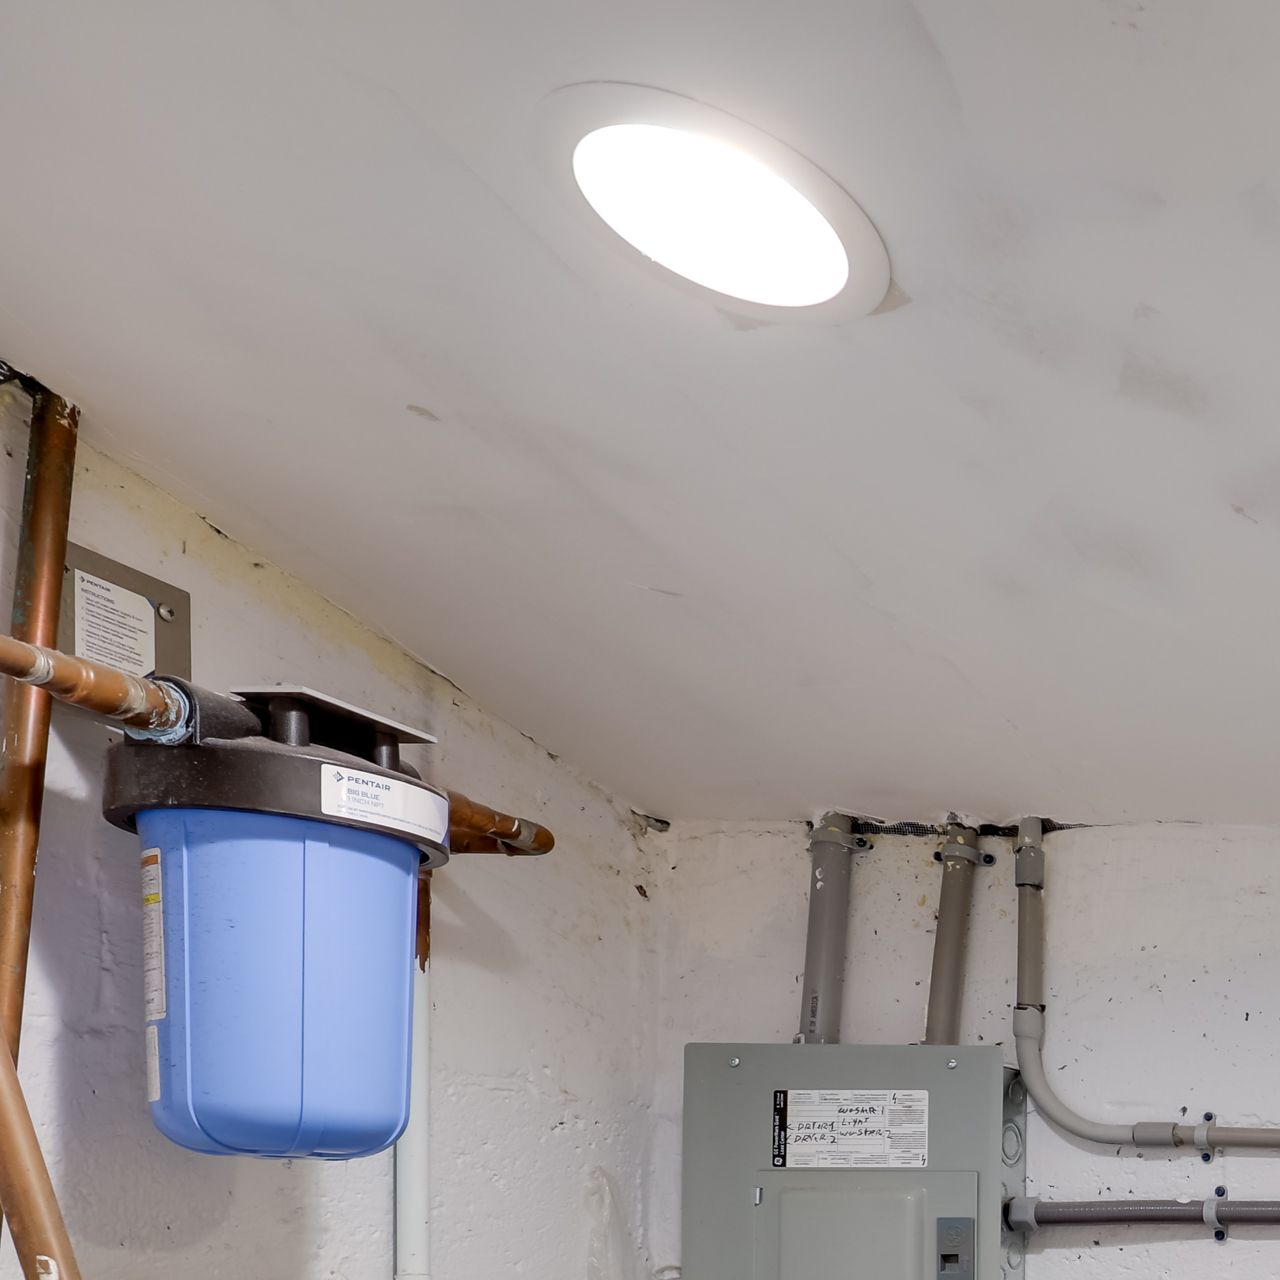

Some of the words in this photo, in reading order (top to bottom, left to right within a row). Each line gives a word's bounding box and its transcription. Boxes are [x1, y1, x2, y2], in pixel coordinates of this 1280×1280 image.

[86, 579, 111, 593] PENTAIR
[347, 775, 391, 792] PENTAIR
[347, 788, 360, 797] BIG
[361, 790, 381, 801] BLUE
